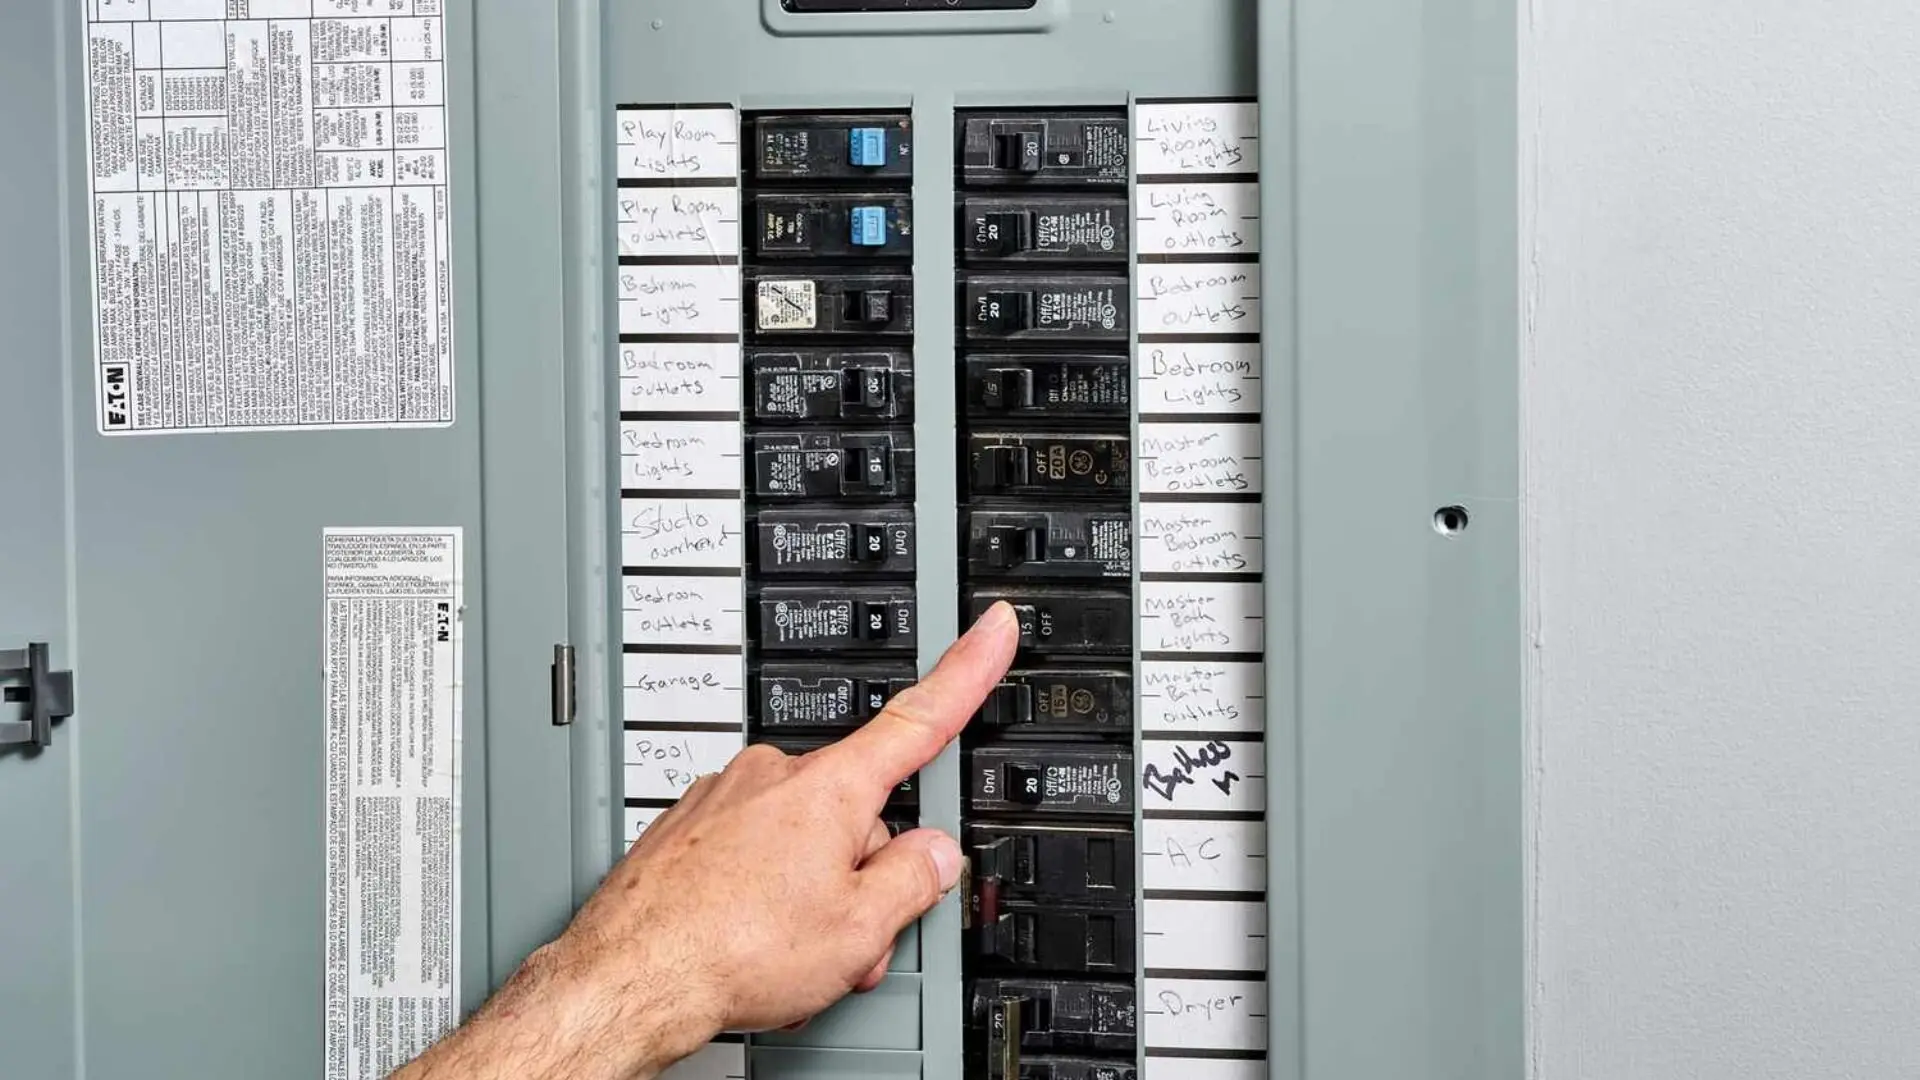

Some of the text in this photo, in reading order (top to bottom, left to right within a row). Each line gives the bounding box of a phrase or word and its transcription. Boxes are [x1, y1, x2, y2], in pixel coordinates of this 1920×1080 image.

[621, 121, 665, 149] Play
[1026, 142, 1038, 156] 20
[635, 156, 701, 173] Lights
[620, 194, 722, 218] Play Room
[988, 224, 998, 240] 20
[990, 302, 1000, 318] 20
[1152, 350, 1251, 377] Bedroom
[867, 378, 880, 394] 20
[1164, 384, 1242, 405] Lights
[635, 458, 693, 480] Lights
[870, 458, 882, 472] 15
[1036, 450, 1048, 474] OFF
[1052, 446, 1064, 479] 20A
[632, 503, 708, 539] Studio
[1143, 517, 1211, 533] Master
[868, 536, 880, 552] 20
[991, 536, 1000, 550] 15
[1145, 594, 1215, 611] Master
[870, 614, 882, 629] 20
[1022, 622, 1033, 636] 15
[1041, 612, 1052, 636] OFF
[1160, 632, 1230, 650] Lights
[639, 672, 720, 693] Garage
[870, 694, 882, 708] 20
[1038, 690, 1049, 713] OFF
[1054, 686, 1066, 715] 15A
[636, 739, 693, 762] Pool
[1026, 778, 1038, 793] 20
[1158, 990, 1242, 1020] Dryer
